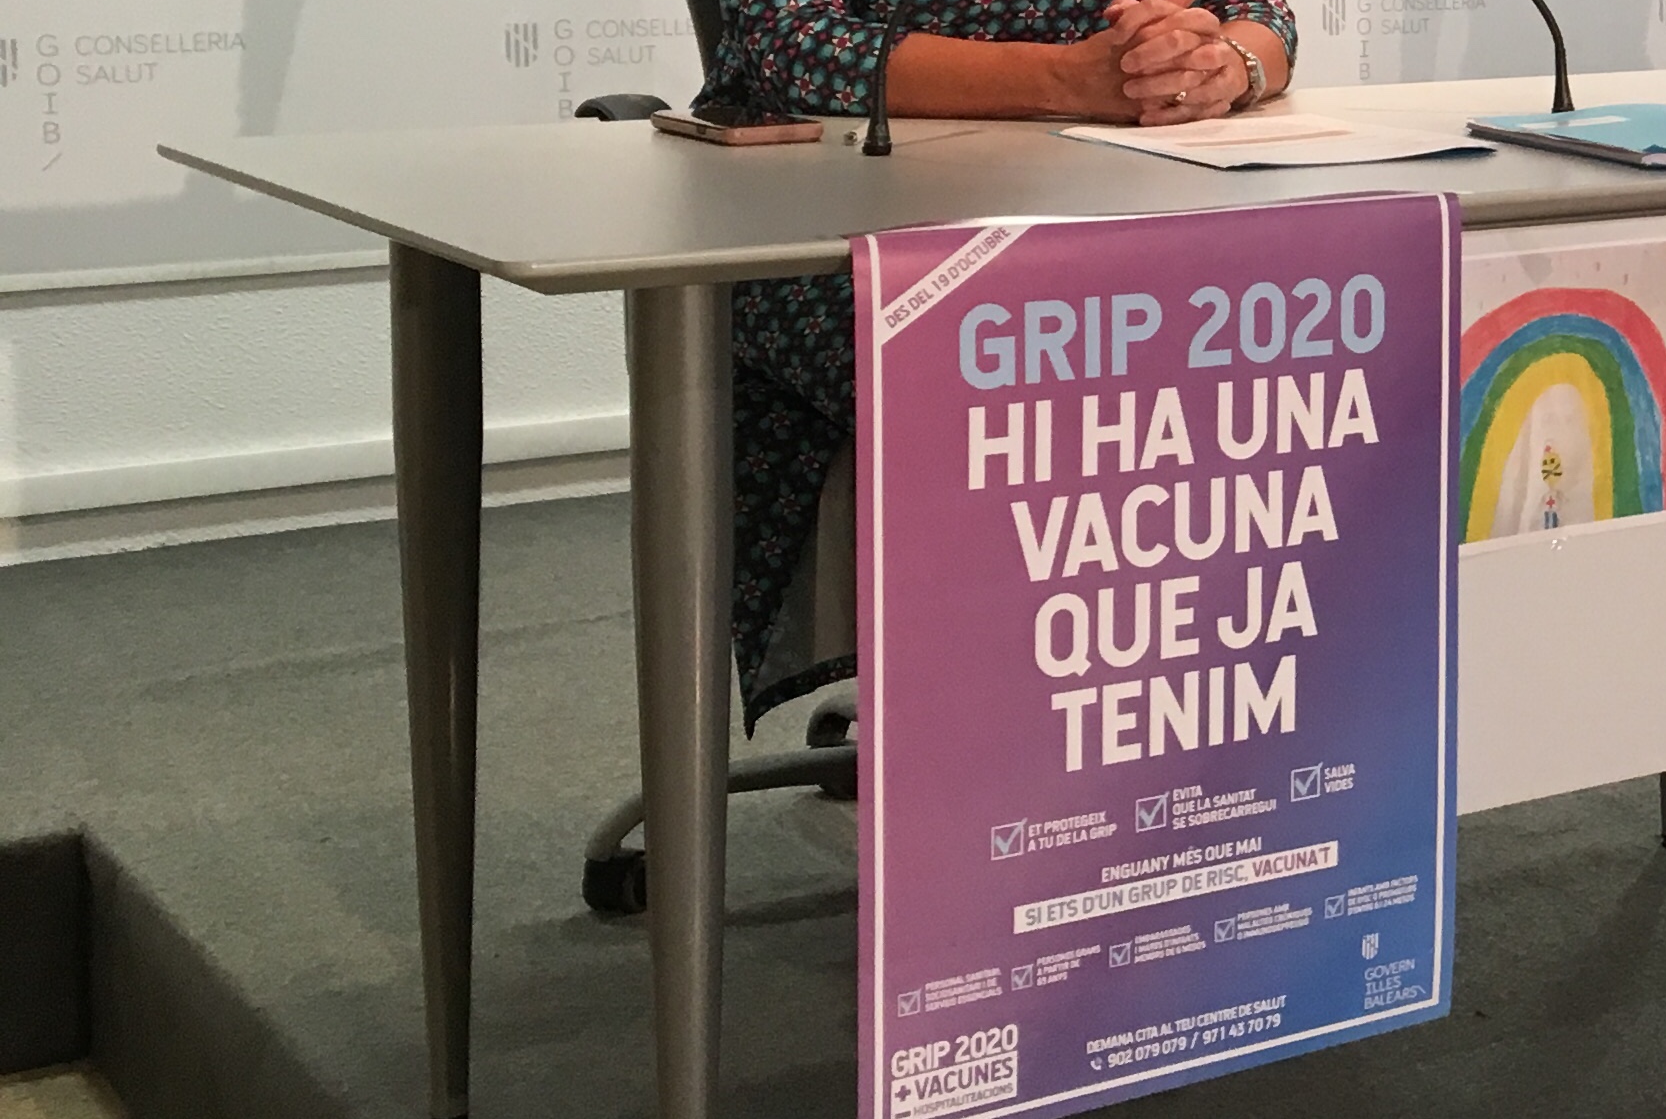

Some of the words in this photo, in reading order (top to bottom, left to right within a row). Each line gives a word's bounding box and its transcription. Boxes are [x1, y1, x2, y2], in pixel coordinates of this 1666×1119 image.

[1380, 17, 1430, 35] SALUT
[75, 32, 248, 57] CONSELLERIA
[587, 45, 657, 66] SALUT
[75, 62, 158, 86] SALUT
[884, 304, 911, 329] DES
[907, 288, 934, 311] DEL
[931, 273, 950, 292] 19
[948, 226, 1011, 280] D'OCTUBRE
[958, 292, 1163, 390] GRIP
[1187, 274, 1386, 368] 2020
[968, 400, 1052, 491] HI
[1081, 387, 1195, 477] HA
[1216, 368, 1380, 460] UNA
[1010, 465, 1340, 582] VACUNA
[1034, 576, 1200, 678] QUE
[1216, 560, 1319, 649] JA
[1051, 654, 1297, 773] TENIM
[1324, 763, 1356, 779] SALVA
[1324, 778, 1354, 793] VIDES
[1172, 785, 1203, 801] EVITA
[1172, 801, 1195, 816] QUE
[1197, 797, 1211, 811] LA
[1213, 788, 1257, 808] SANITAT
[1028, 824, 1042, 838] ET
[1043, 810, 1106, 834] PROTEGEIX
[1172, 816, 1187, 830] SE
[1188, 799, 1277, 827] SOBRECARREGUI
[1027, 838, 1037, 852] A
[1038, 835, 1054, 850] TU
[1055, 832, 1071, 847] DE
[1072, 829, 1087, 843] LA
[1089, 823, 1118, 840] GRIP
[1101, 853, 1171, 883] ENGUANY
[1204, 842, 1234, 862] QUE
[1235, 836, 1263, 856] MAI
[1024, 907, 1042, 926] SI
[1046, 899, 1079, 922] ETS
[1082, 889, 1123, 914] D'UN
[1127, 878, 1178, 905] GRUP
[1181, 873, 1203, 893] DE
[1206, 864, 1249, 888] RISC,
[1251, 846, 1331, 878] VACUNA'T
[1364, 959, 1416, 981] GOVERN
[1364, 986, 1418, 1010] BALEARS
[1365, 976, 1402, 996] ILLES
[1086, 1033, 1134, 1055] DEMANA
[1135, 1025, 1158, 1042] CITA
[1159, 1023, 1172, 1037] AL
[1174, 1017, 1195, 1033] TEU
[1196, 1006, 1238, 1027] CENTRE
[1238, 1003, 1252, 1017] DE
[1252, 994, 1287, 1014] SALUT
[891, 1040, 951, 1078] GRIP
[954, 1023, 1018, 1063] 2020
[1107, 1049, 1133, 1069] 902
[1134, 1043, 1160, 1062] 079
[1161, 1037, 1187, 1056] 079
[1202, 1028, 1225, 1046] 971
[1228, 1021, 1245, 1038] 43
[1247, 1017, 1264, 1034] 70
[1265, 1012, 1281, 1029] 79
[914, 1056, 1014, 1101] VACUNES
